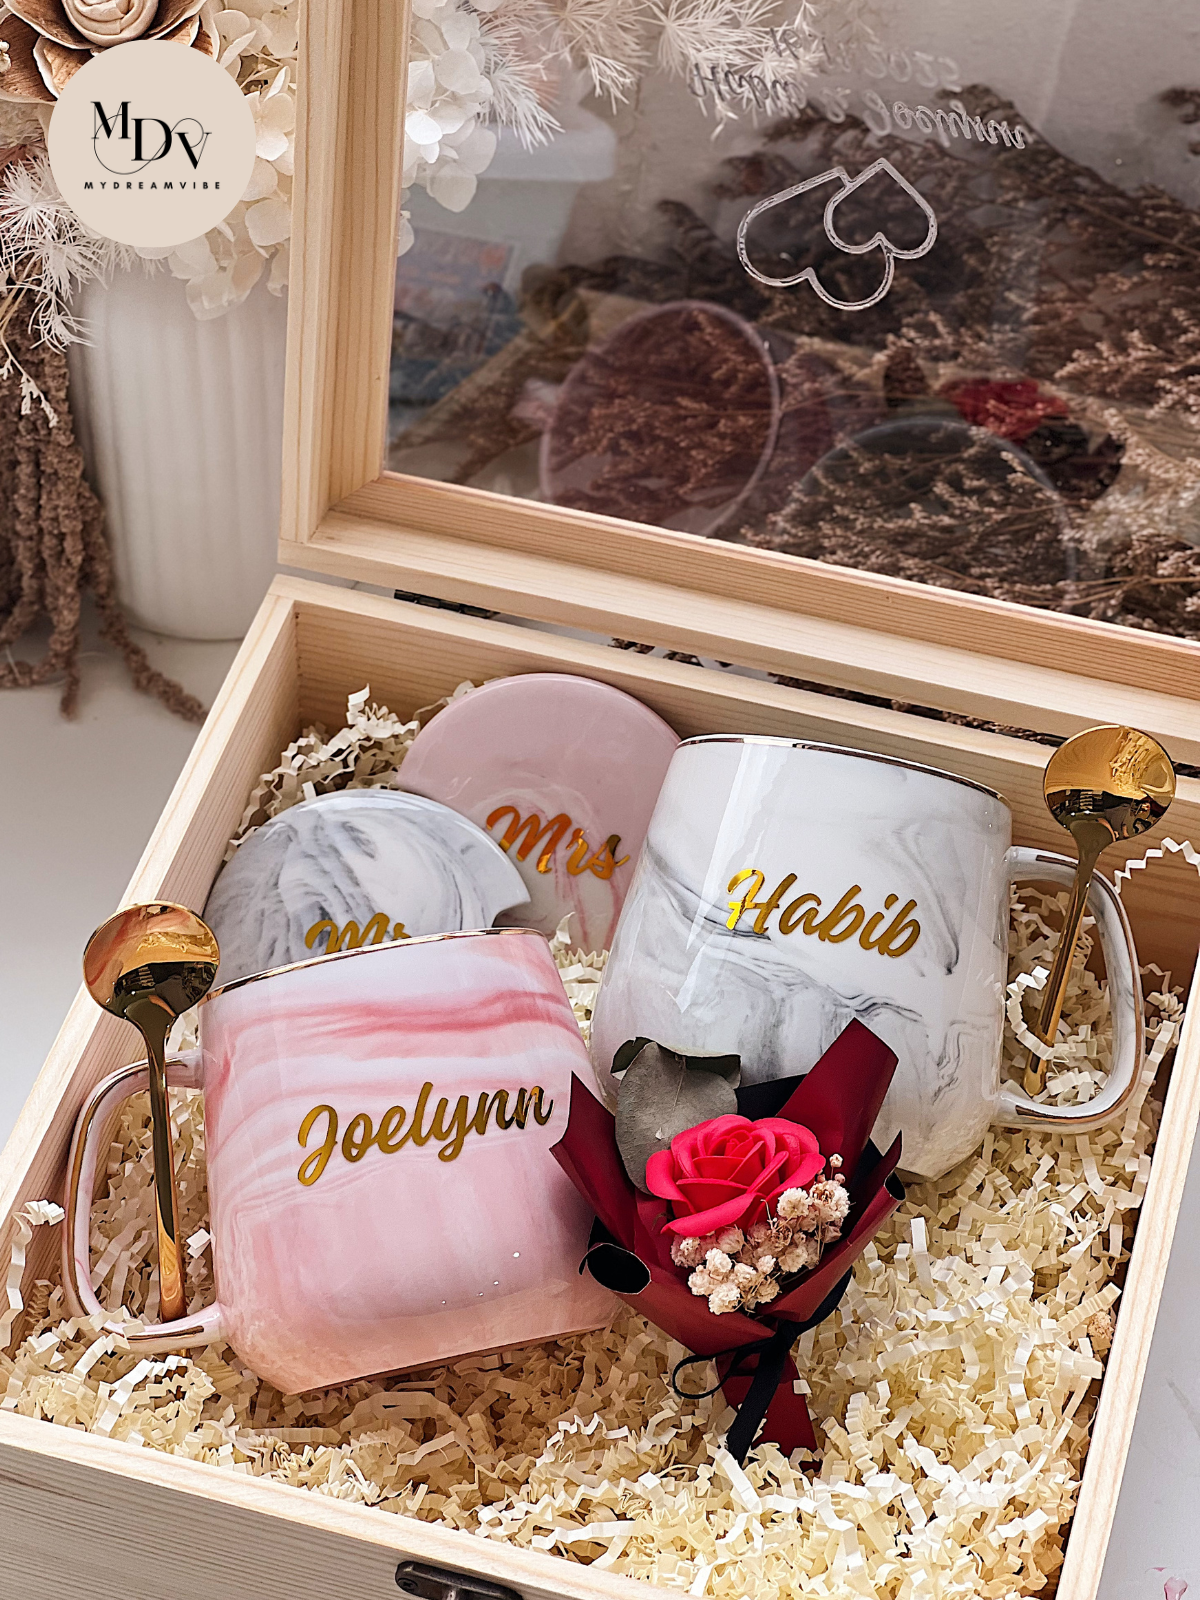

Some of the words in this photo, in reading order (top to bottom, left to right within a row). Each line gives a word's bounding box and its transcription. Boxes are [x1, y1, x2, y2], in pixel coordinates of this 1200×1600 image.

[486, 805, 631, 880] Mrs
[726, 868, 921, 958] Habib
[298, 1081, 554, 1187] Joelynn
